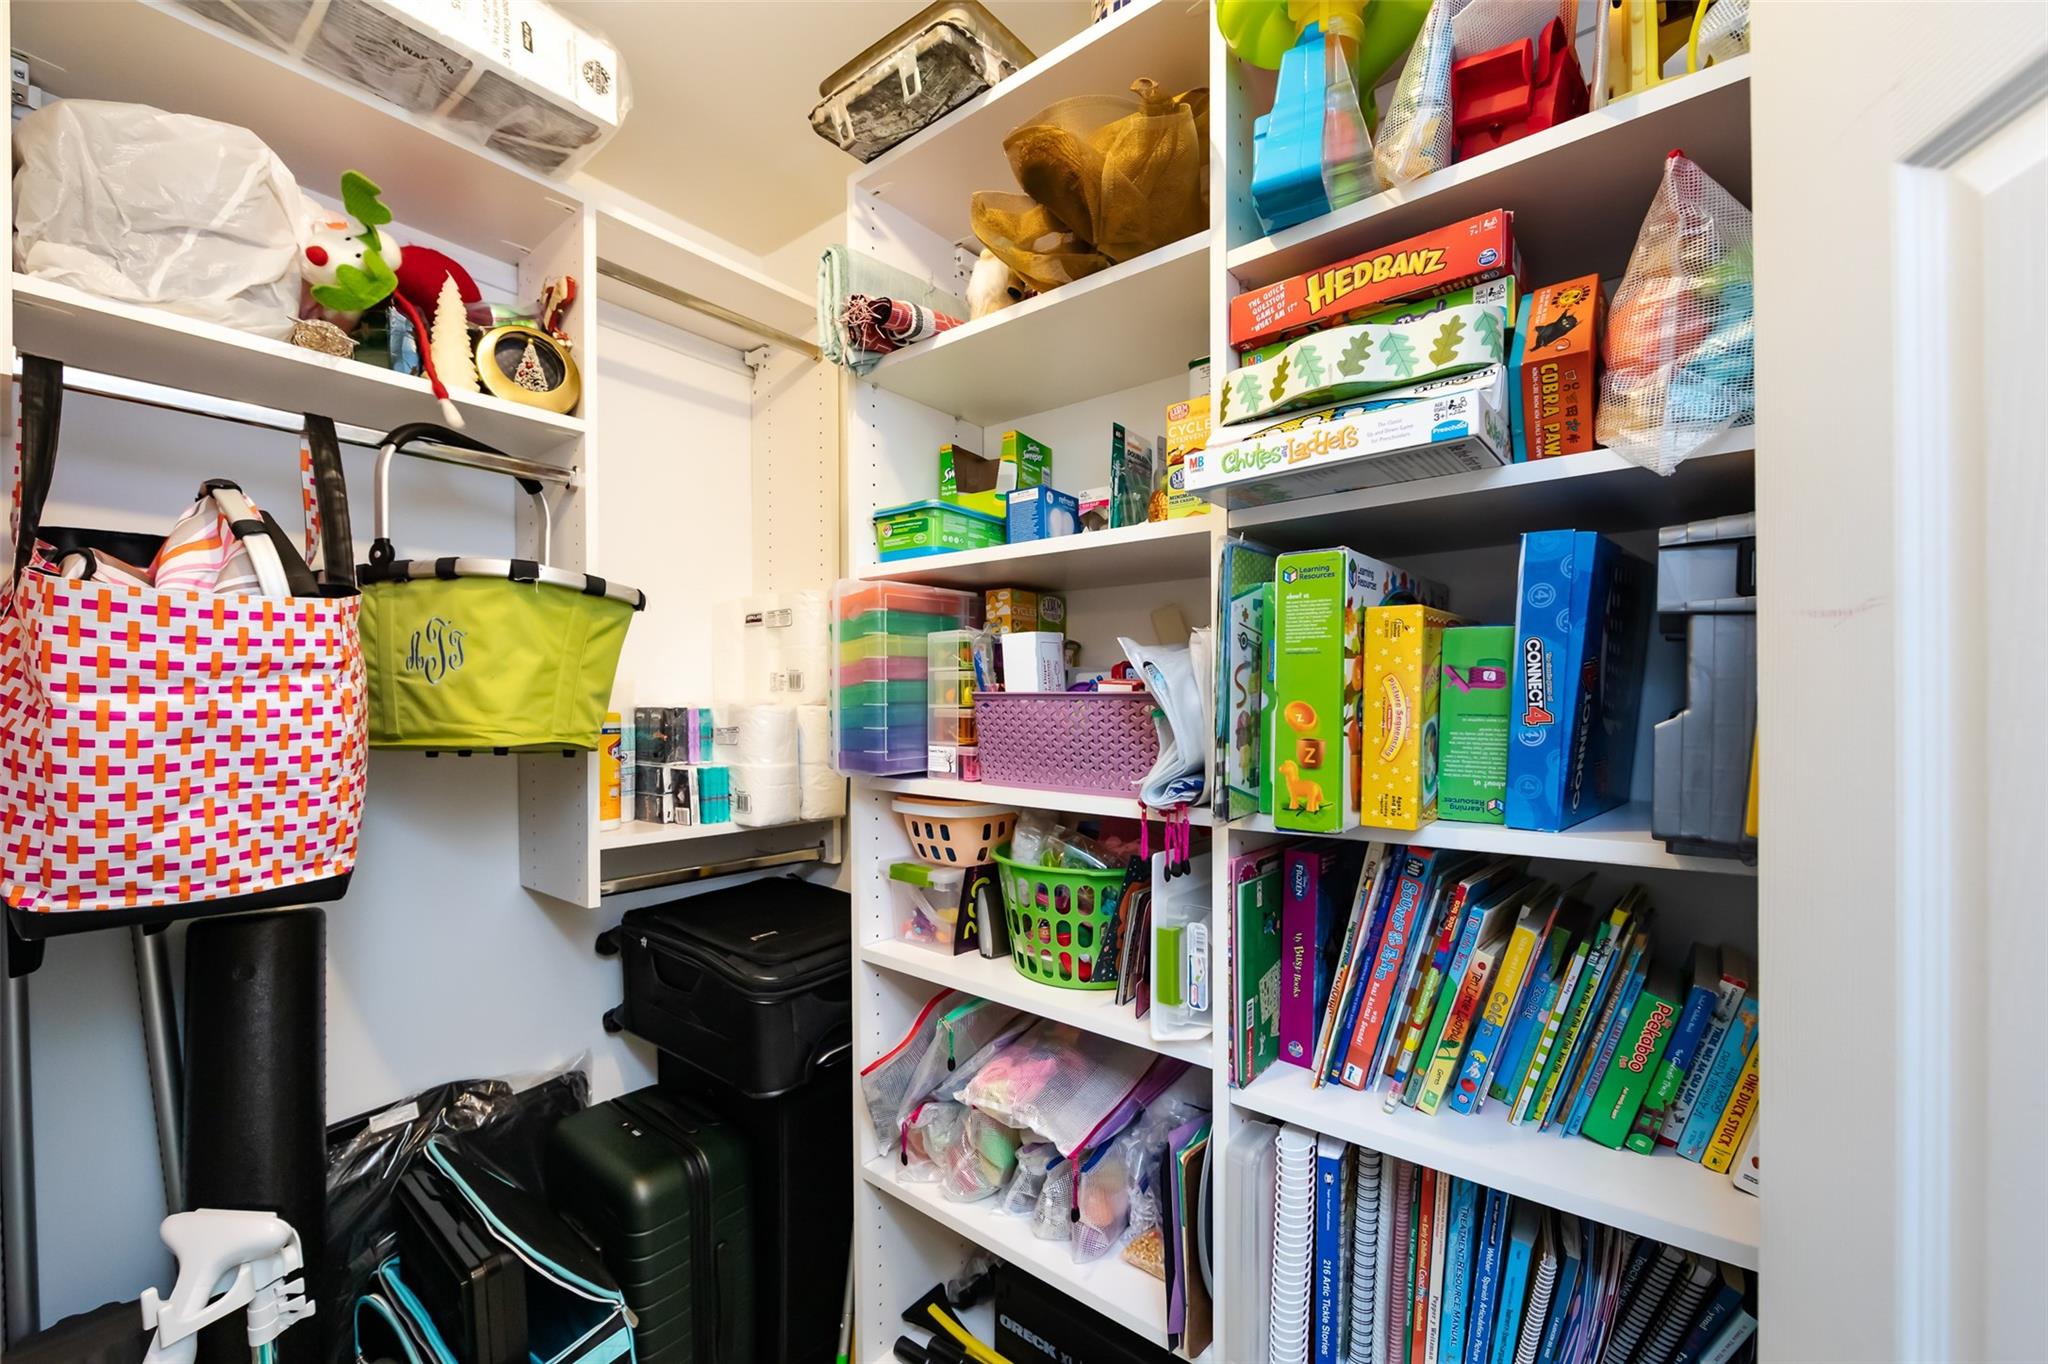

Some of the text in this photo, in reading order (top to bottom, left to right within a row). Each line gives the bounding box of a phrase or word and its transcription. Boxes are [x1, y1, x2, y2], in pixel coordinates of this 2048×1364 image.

[1304, 247, 1447, 315] HEDBANZ
[1248, 284, 1285, 309] THE QUICK
[1252, 292, 1285, 315] QUESTION
[1256, 301, 1285, 322] GAME OF
[1274, 312, 1285, 320] AM
[1434, 413, 1445, 421] 3+
[1538, 362, 1562, 454] COBRA PAW
[1433, 422, 1467, 434] Preschool
[1189, 456, 1204, 469] MB
[1221, 443, 1283, 474] Chutes
[1286, 424, 1359, 464] Ladders
[1300, 565, 1330, 574] Learning
[1300, 572, 1335, 580] Resources
[1358, 566, 1375, 581] Learning
[1358, 575, 1377, 591] Resources
[1388, 677, 1403, 707] Picture
[1522, 638, 1553, 725] CONNECT 4
[1384, 710, 1403, 757] Sequencing
[1304, 748, 1316, 763] Z
[1568, 692, 1594, 809] CONNECT
[1484, 781, 1506, 789] about
[1389, 808, 1396, 816] Up
[1444, 797, 1485, 806] Resources
[1450, 802, 1485, 814] Learning
[1294, 864, 1304, 896] FROZEN
[1388, 879, 1419, 932] Sounds
[1443, 899, 1462, 932] Toca, toca
[1452, 915, 1480, 972] 10 Teddy Bears
[1292, 932, 1304, 998] My Busy Books
[1373, 943, 1400, 983] Farm
[1468, 970, 1483, 987] Ten
[1562, 973, 1576, 995] My Body
[1458, 985, 1479, 1011] Little
[1520, 984, 1546, 1021] Zoo Day
[1355, 981, 1379, 1046] Real Animal Sounds!
[1369, 1010, 1379, 1024] with
[1480, 989, 1511, 1039] Colors
[1552, 982, 1595, 1075] One fish two fish red fish blue fish
[1609, 1018, 1624, 1041] LLAMA
[1623, 1000, 1675, 1076] Peekaboo
[1600, 1039, 1615, 1061] LLAMA
[1681, 1025, 1724, 1107] THERE WAS AN OLD LADY
[1741, 1072, 1760, 1094] ONE
[1729, 1090, 1752, 1119] DUCK
[1717, 1115, 1741, 1147] STUCK
[1419, 1223, 1428, 1238] Early
[1418, 1239, 1427, 1268] Childhood
[1414, 1268, 1427, 1303] Coaching
[1448, 1206, 1470, 1347] TREATMENT RESOURCE MANUAL
[1618, 1253, 1647, 1298] Teach Me
[1320, 1258, 1331, 1355] 216 Artic Tickle Stories
[1414, 1303, 1423, 1330] Handbook
[1430, 1295, 1439, 1318] Pepper
[1470, 1276, 1491, 1362] Spanish Articulation Picture
[1000, 1313, 1057, 1360] ORECK
[1428, 1327, 1437, 1360] Weitzman
